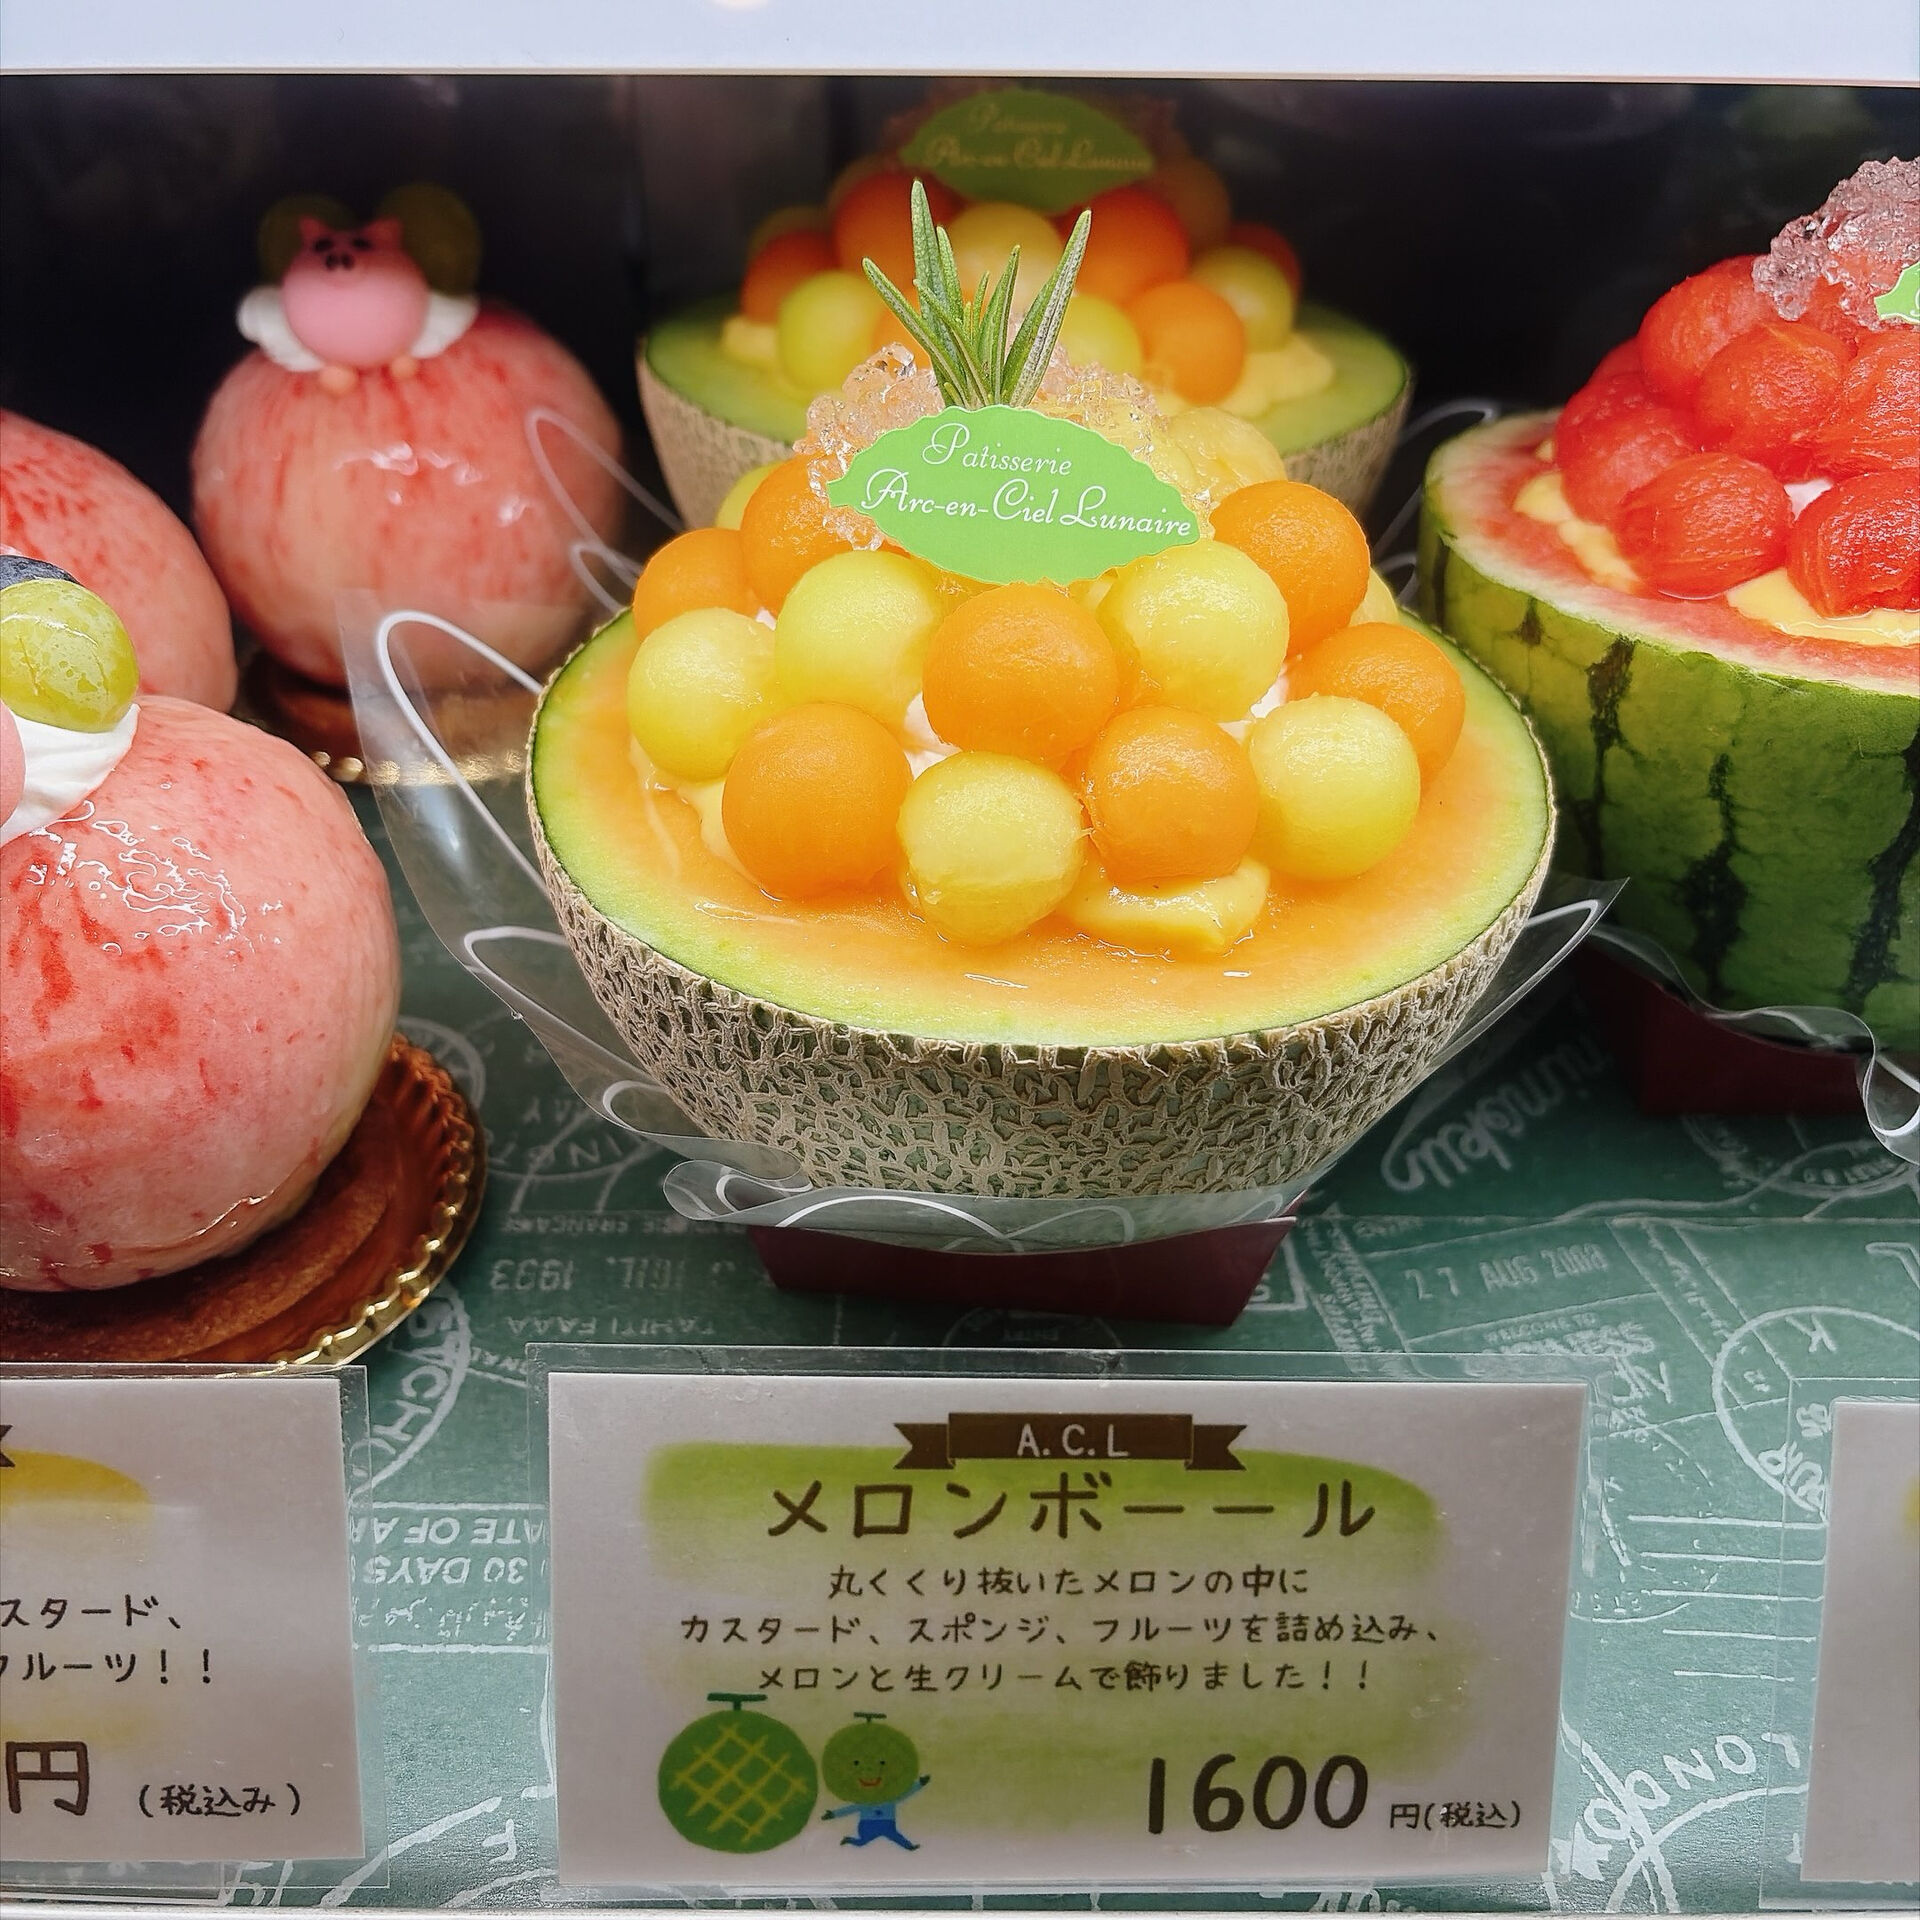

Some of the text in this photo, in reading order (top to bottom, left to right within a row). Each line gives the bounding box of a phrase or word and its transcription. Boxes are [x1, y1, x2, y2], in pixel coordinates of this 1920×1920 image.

[922, 422, 1072, 476] Patisserie
[861, 468, 1191, 537] Arc-en-Ciel Lunaire
[1017, 1422, 1131, 1458] A.C.L
[767, 1470, 1376, 1540] メロンボーール
[403, 1517, 461, 1546] OF
[362, 1555, 529, 1586] 30 DAYS
[828, 1564, 1309, 1599] 丸くくり抜いたメロンの中に
[680, 1610, 1437, 1645] カスタード、スポンジ、フルーツを詰め込み、
[758, 1659, 1369, 1692] メロンと生クリームで飾りました！！
[5, 1740, 90, 1817] 円
[1147, 1753, 1369, 1835] 1600
